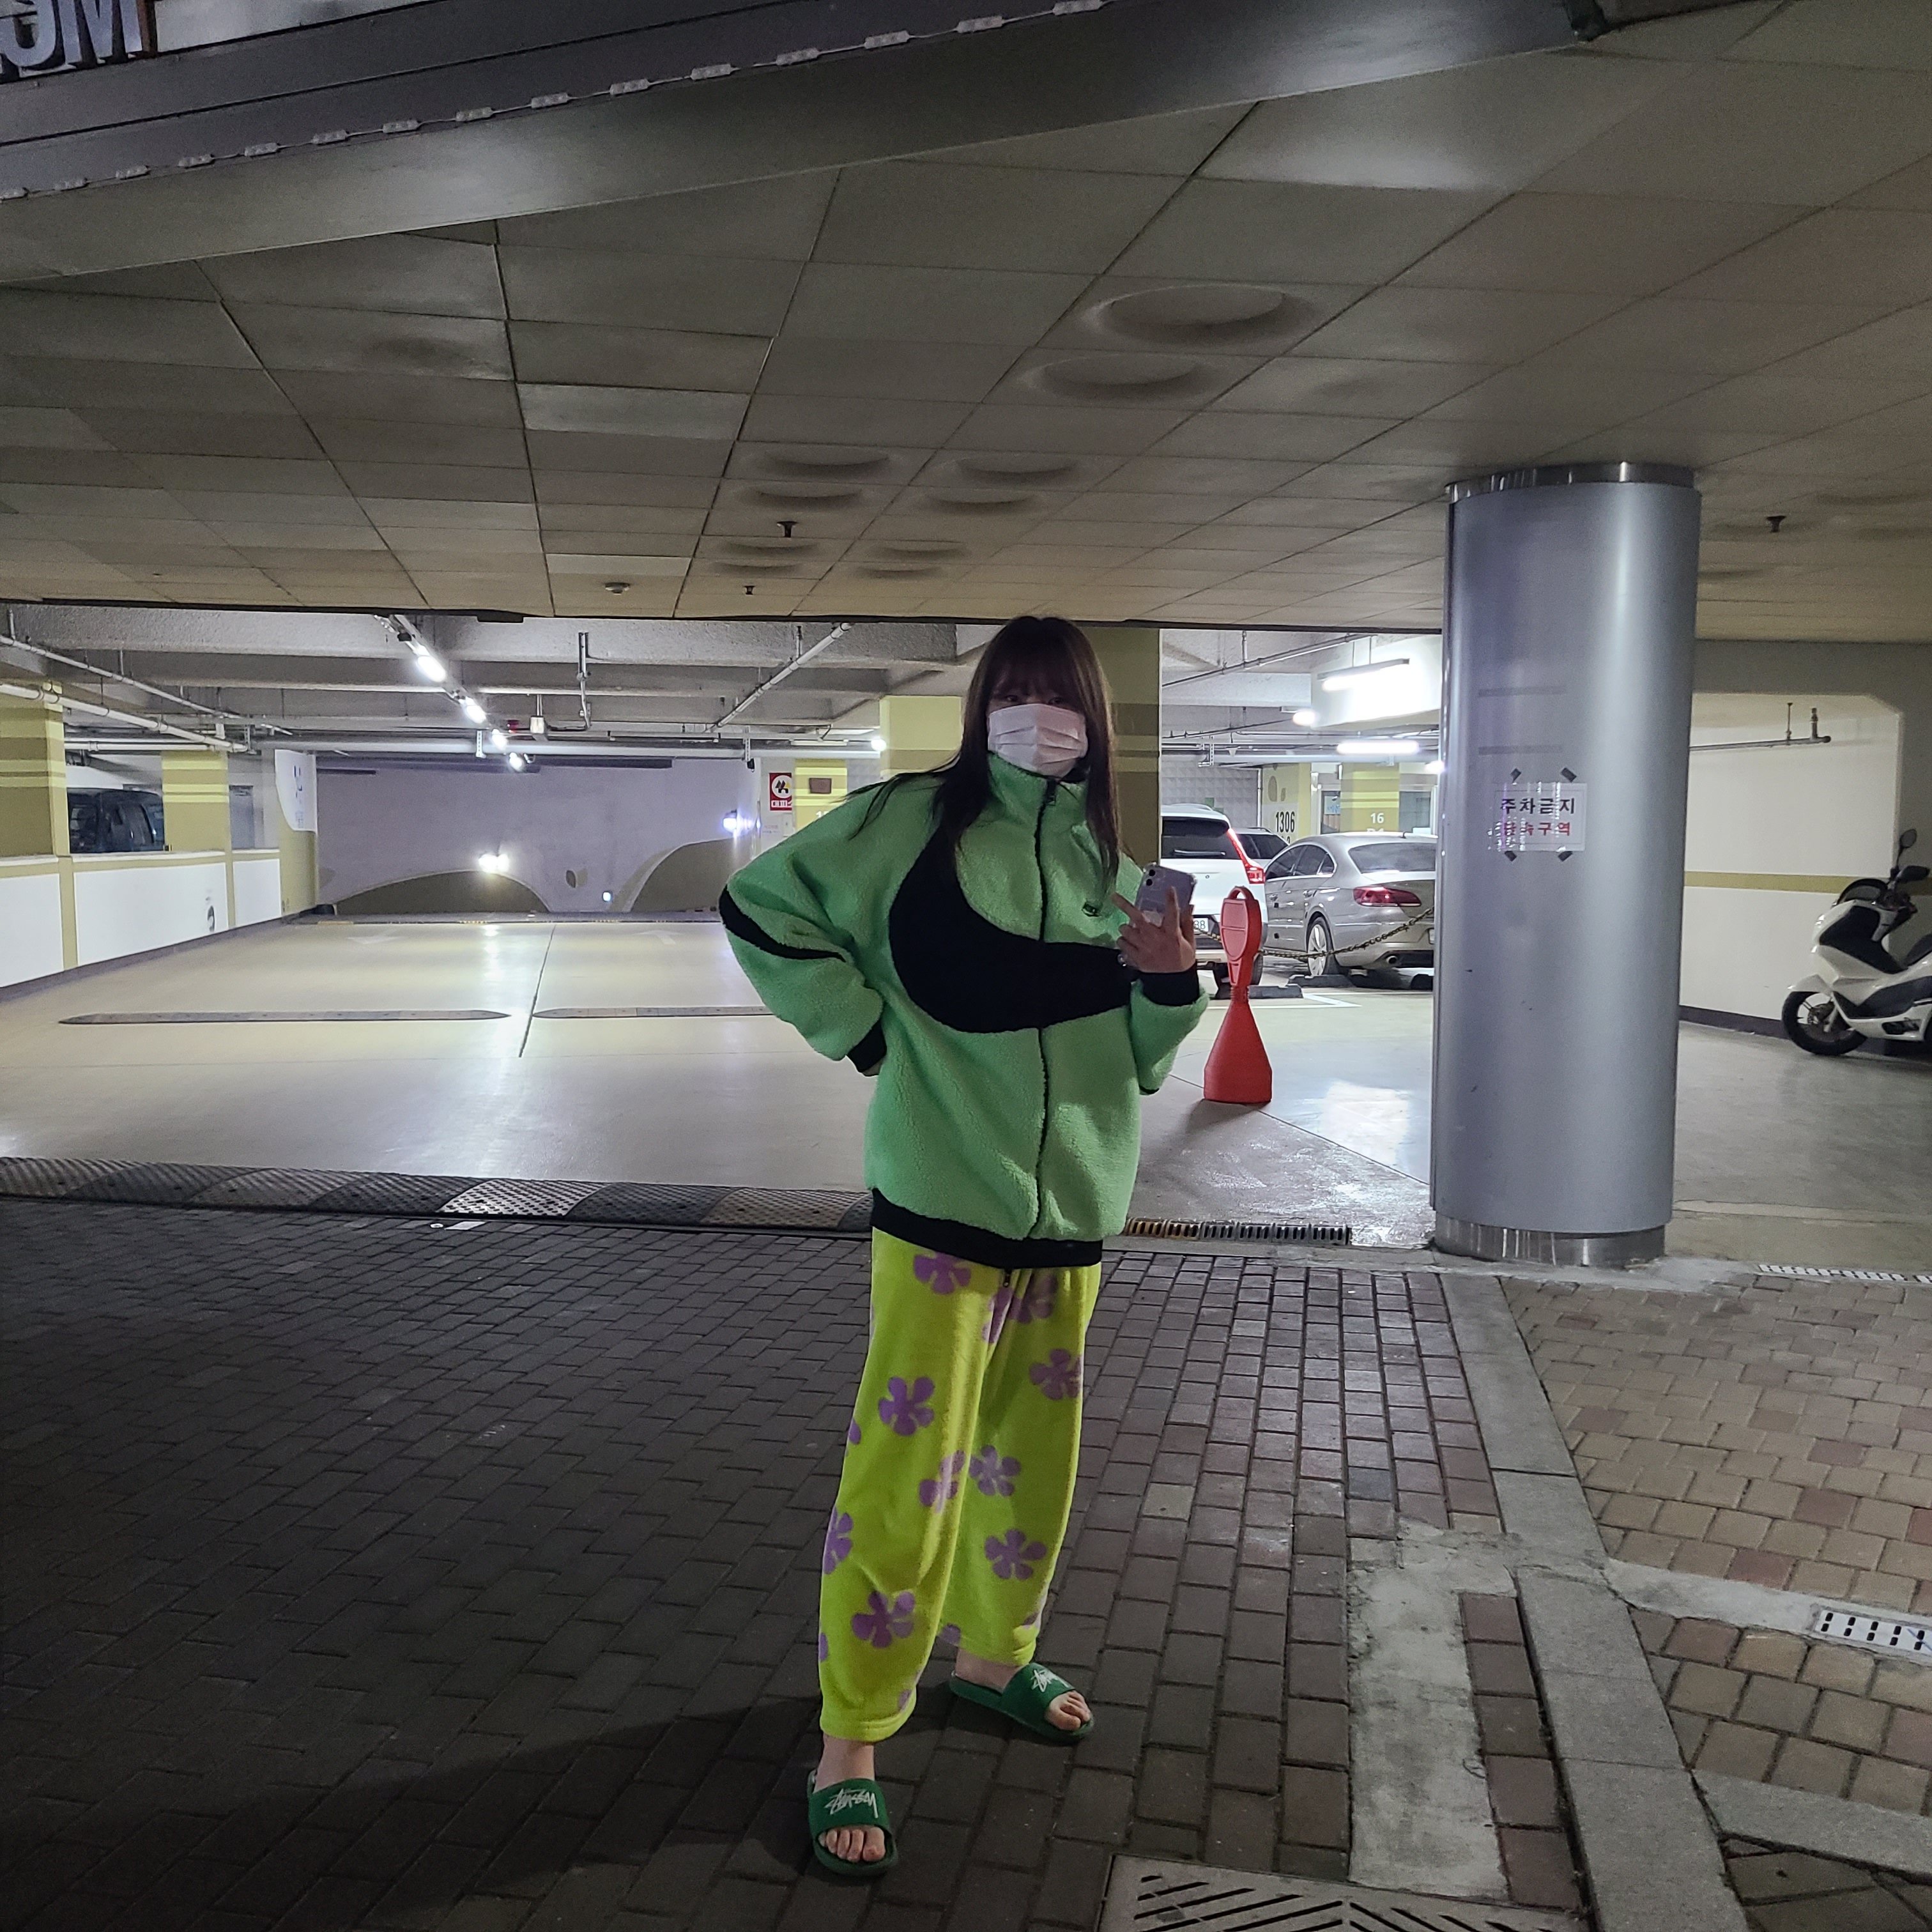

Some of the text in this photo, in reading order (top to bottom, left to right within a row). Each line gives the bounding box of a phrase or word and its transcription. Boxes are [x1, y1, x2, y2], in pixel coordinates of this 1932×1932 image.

[1500, 797, 1575, 815] 주차금지
[1275, 811, 1295, 832] 1306
[1370, 812, 1384, 824] 16
